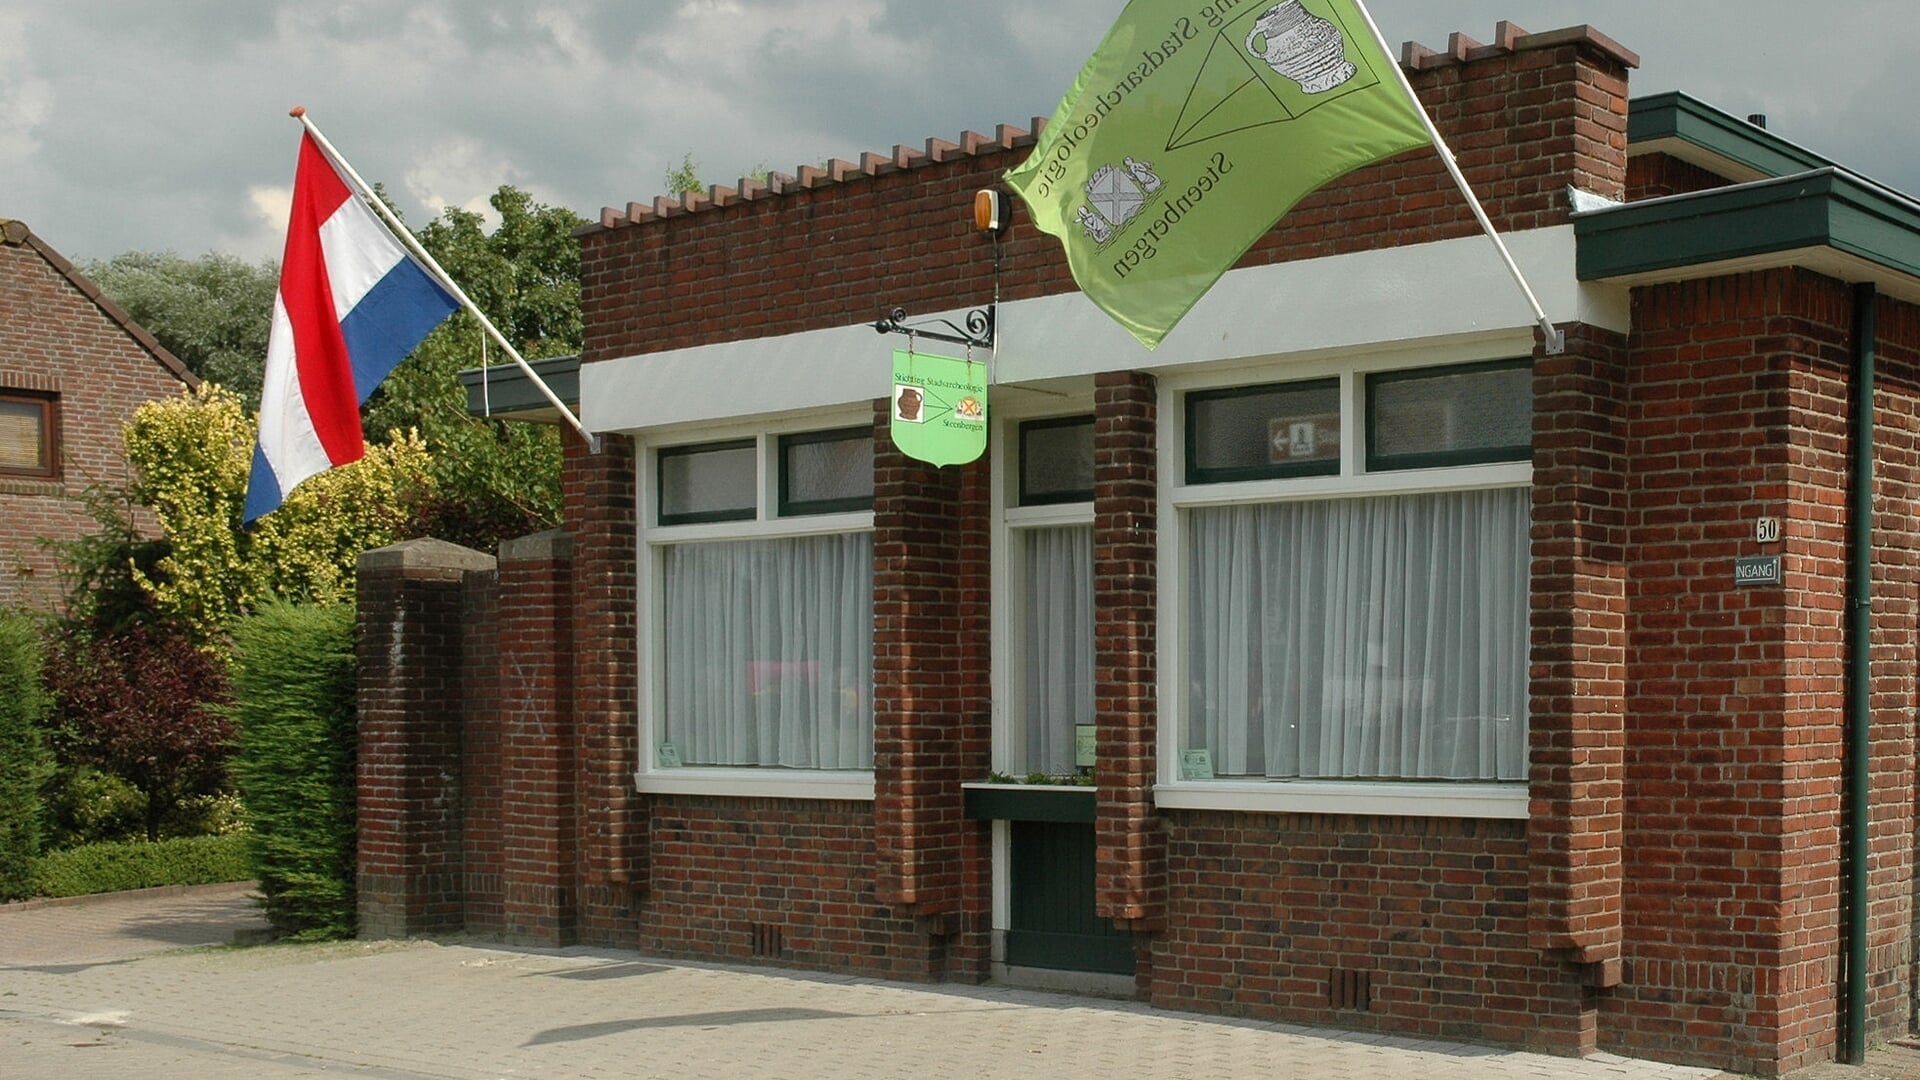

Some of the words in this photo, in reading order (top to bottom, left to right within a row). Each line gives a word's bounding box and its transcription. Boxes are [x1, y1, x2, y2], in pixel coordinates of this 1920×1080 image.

[894, 372, 925, 385] Stichting
[943, 419, 983, 432] Steenbergen
[1759, 519, 1776, 539] 50
